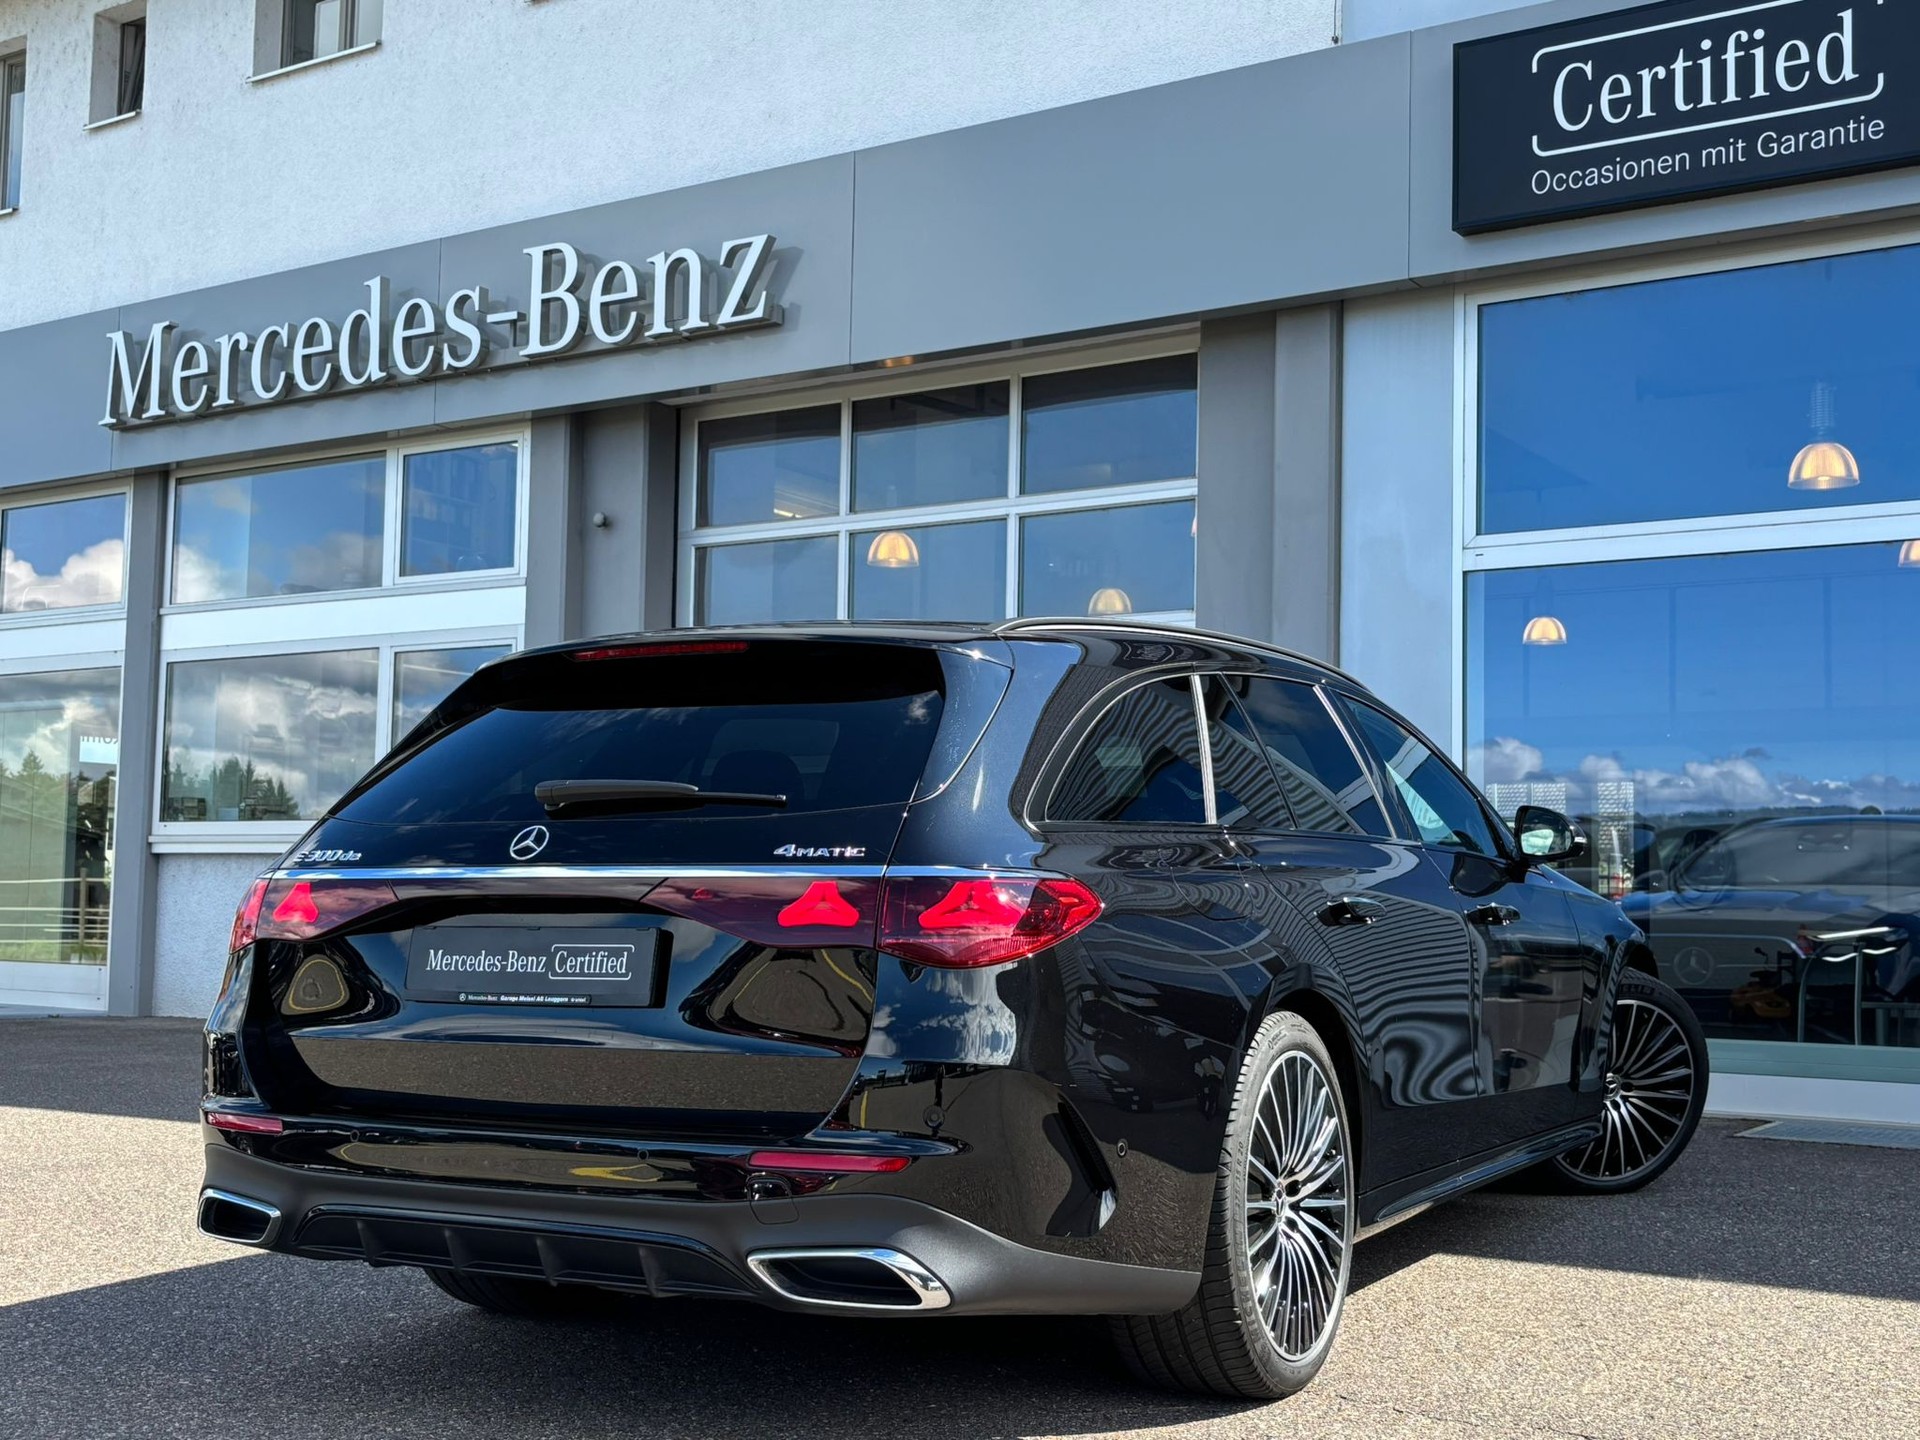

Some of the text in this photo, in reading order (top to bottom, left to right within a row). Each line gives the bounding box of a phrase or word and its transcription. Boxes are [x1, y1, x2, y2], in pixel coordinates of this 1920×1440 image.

[1552, 8, 1859, 132] Certified
[1531, 115, 1885, 195] Occasionen mit Garantie
[98, 233, 778, 428] Mercedes-Benz
[773, 844, 866, 857] 4MATIC
[425, 949, 628, 974] Mercedes-Benz Certified
[500, 995, 518, 1003] Garage
